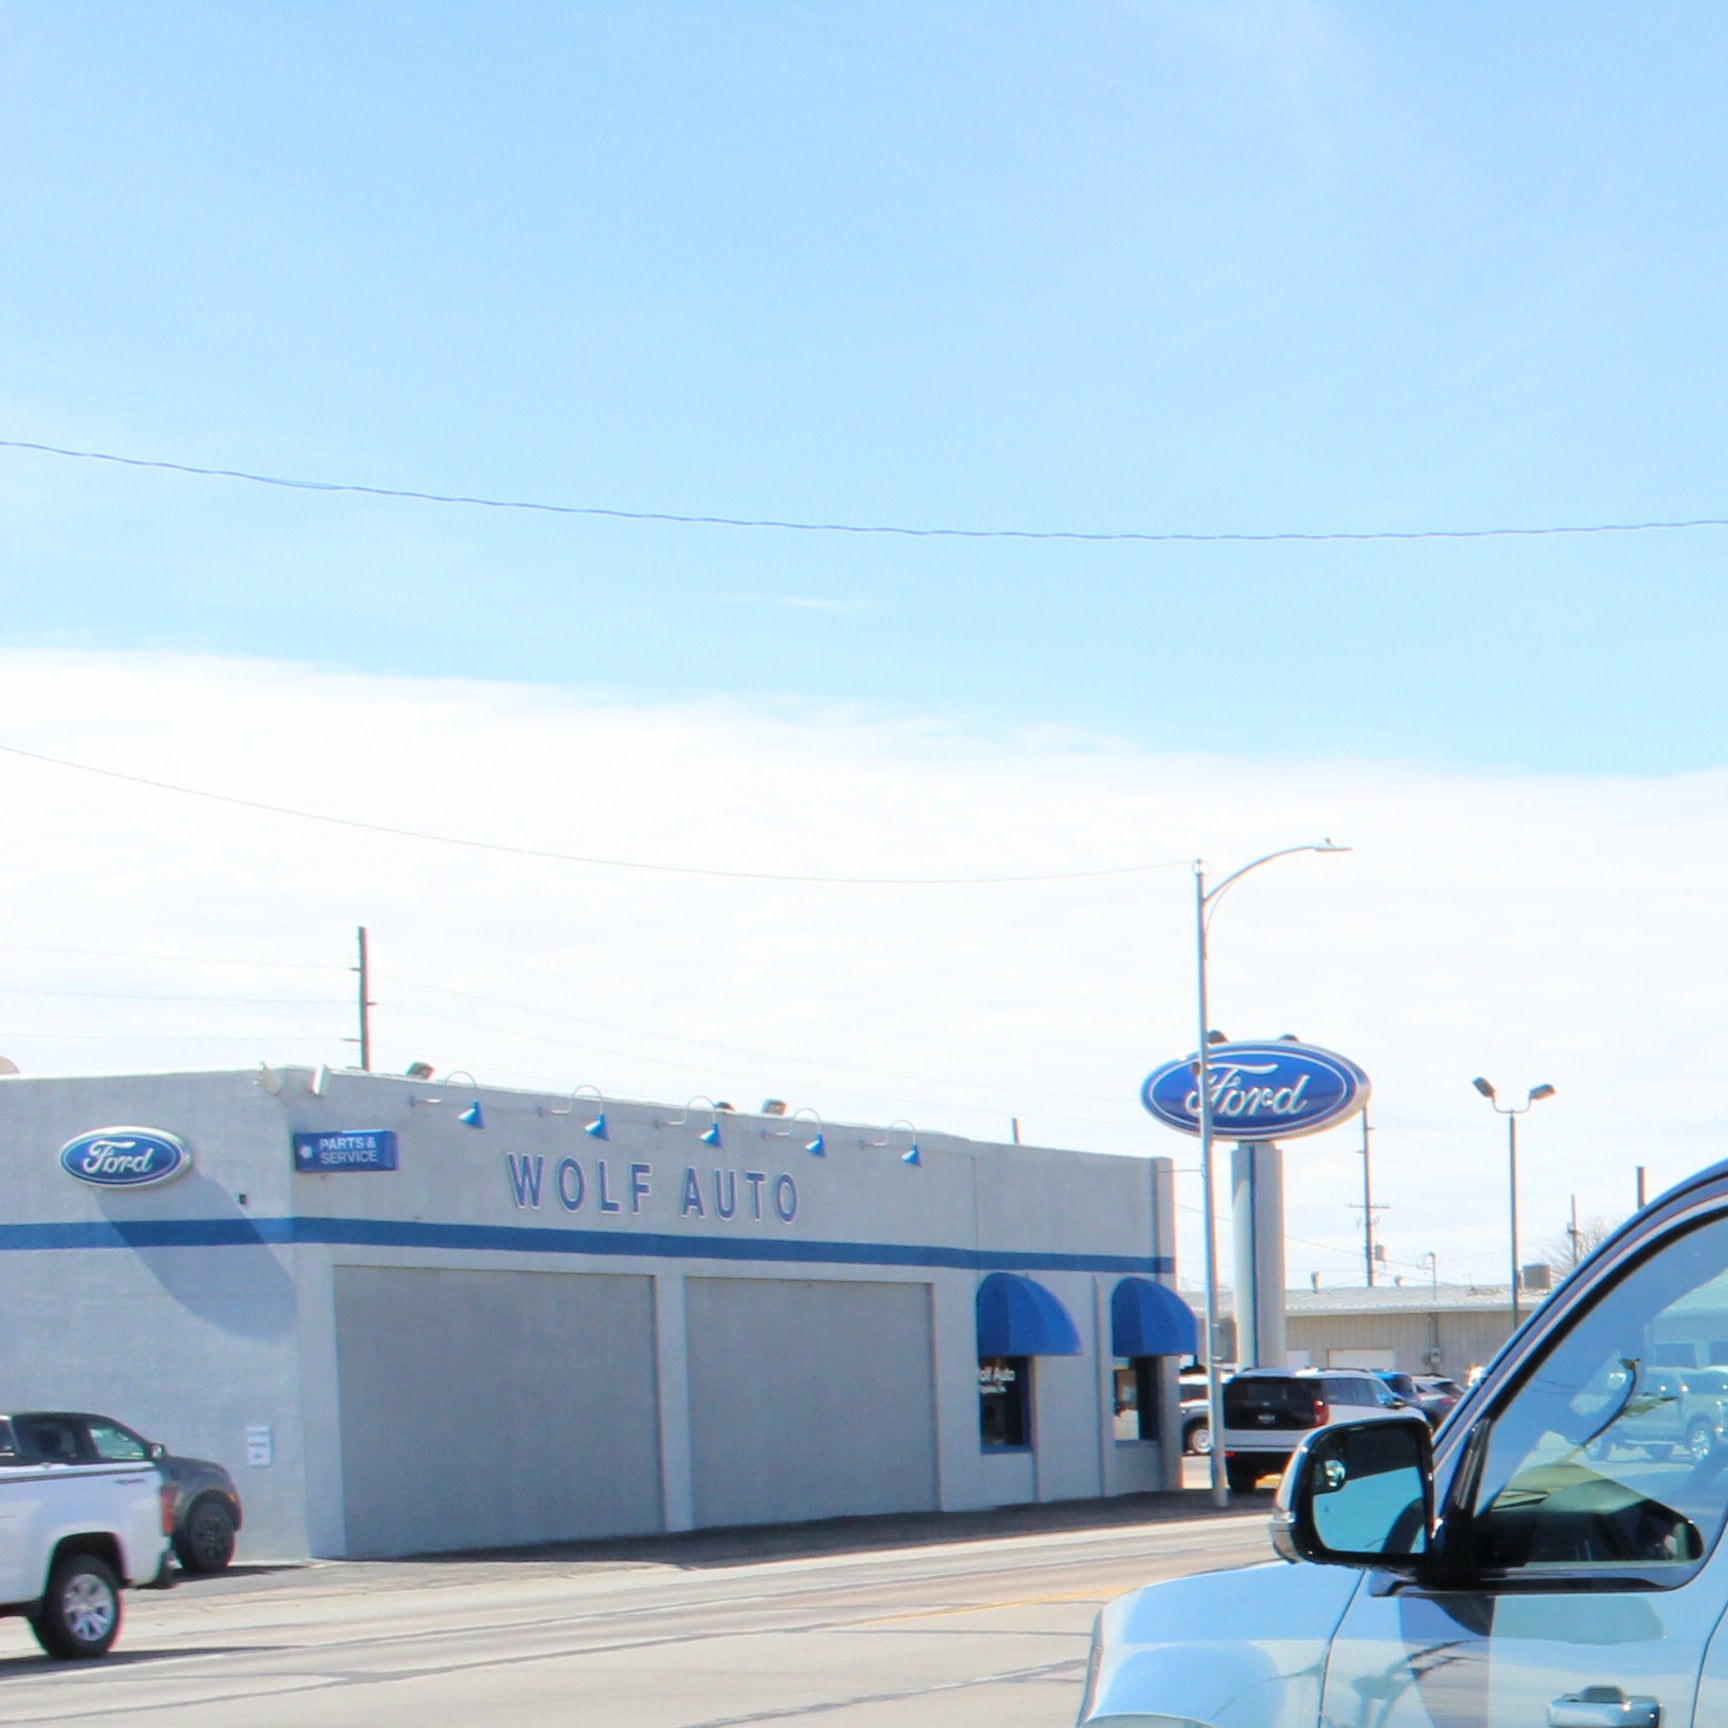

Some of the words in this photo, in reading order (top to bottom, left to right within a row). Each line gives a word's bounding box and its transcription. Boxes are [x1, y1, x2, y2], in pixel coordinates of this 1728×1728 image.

[1185, 1063, 1311, 1117] Ford
[82, 1139, 155, 1175] Ford
[320, 1137, 363, 1151] PARTS
[364, 1136, 377, 1150] &
[320, 1150, 379, 1165] SERVICE
[506, 1152, 652, 1216] WOLF
[681, 1165, 799, 1225] AUTO
